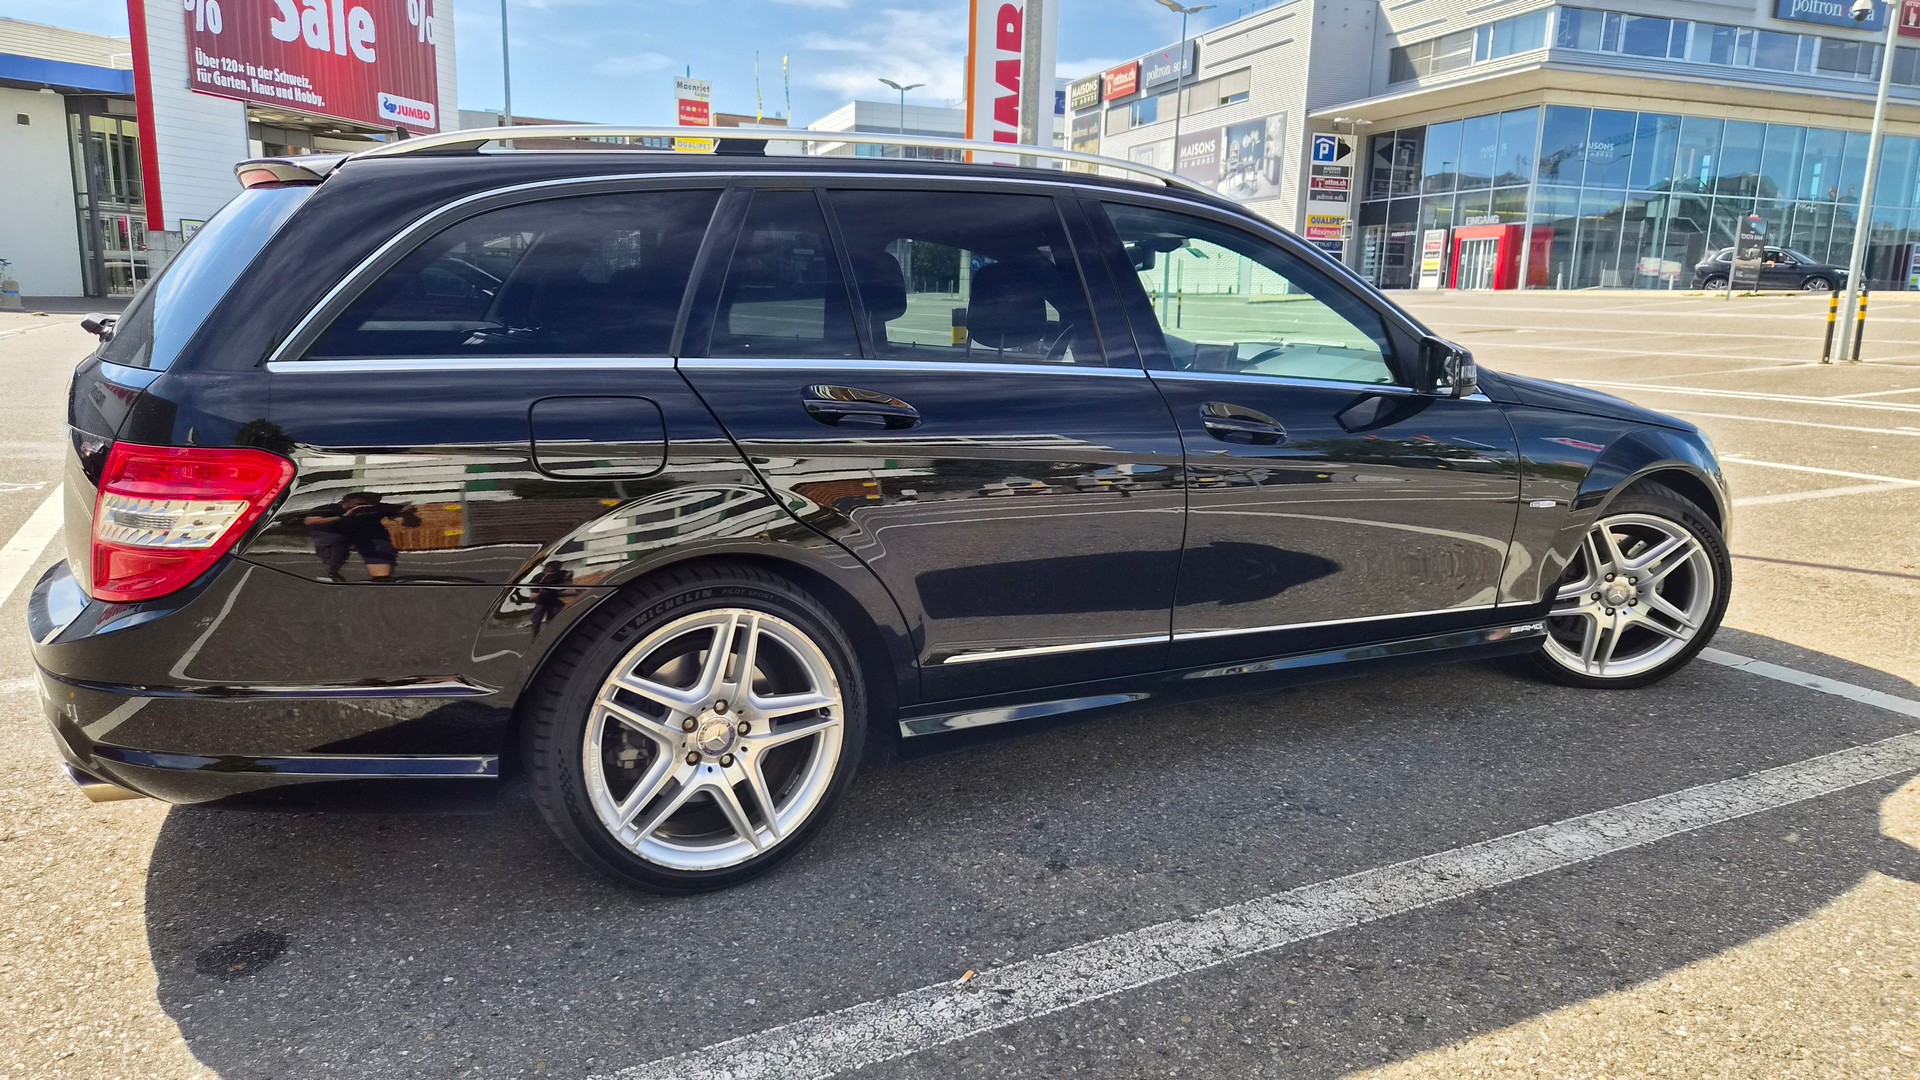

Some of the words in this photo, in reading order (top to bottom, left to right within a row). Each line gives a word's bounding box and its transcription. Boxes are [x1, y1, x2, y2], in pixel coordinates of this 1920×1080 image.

[271, 0, 376, 63] Sale
[195, 47, 219, 69] Über
[246, 62, 256, 77] in
[257, 65, 274, 81] der
[274, 68, 313, 90] Schweiz,
[196, 68, 212, 83] für
[213, 71, 250, 93] Garten,
[251, 78, 275, 97] Haus
[276, 86, 293, 100] und
[294, 87, 325, 106] Hobby.
[1071, 79, 1097, 98] MAISONS
[396, 105, 431, 121] JUMBO
[678, 141, 711, 150] QUALIPET
[1180, 139, 1216, 158] MAISONS
[1319, 143, 1330, 160] P
[1465, 215, 1500, 226] EINGANG
[635, 588, 713, 628] MICHELIN
